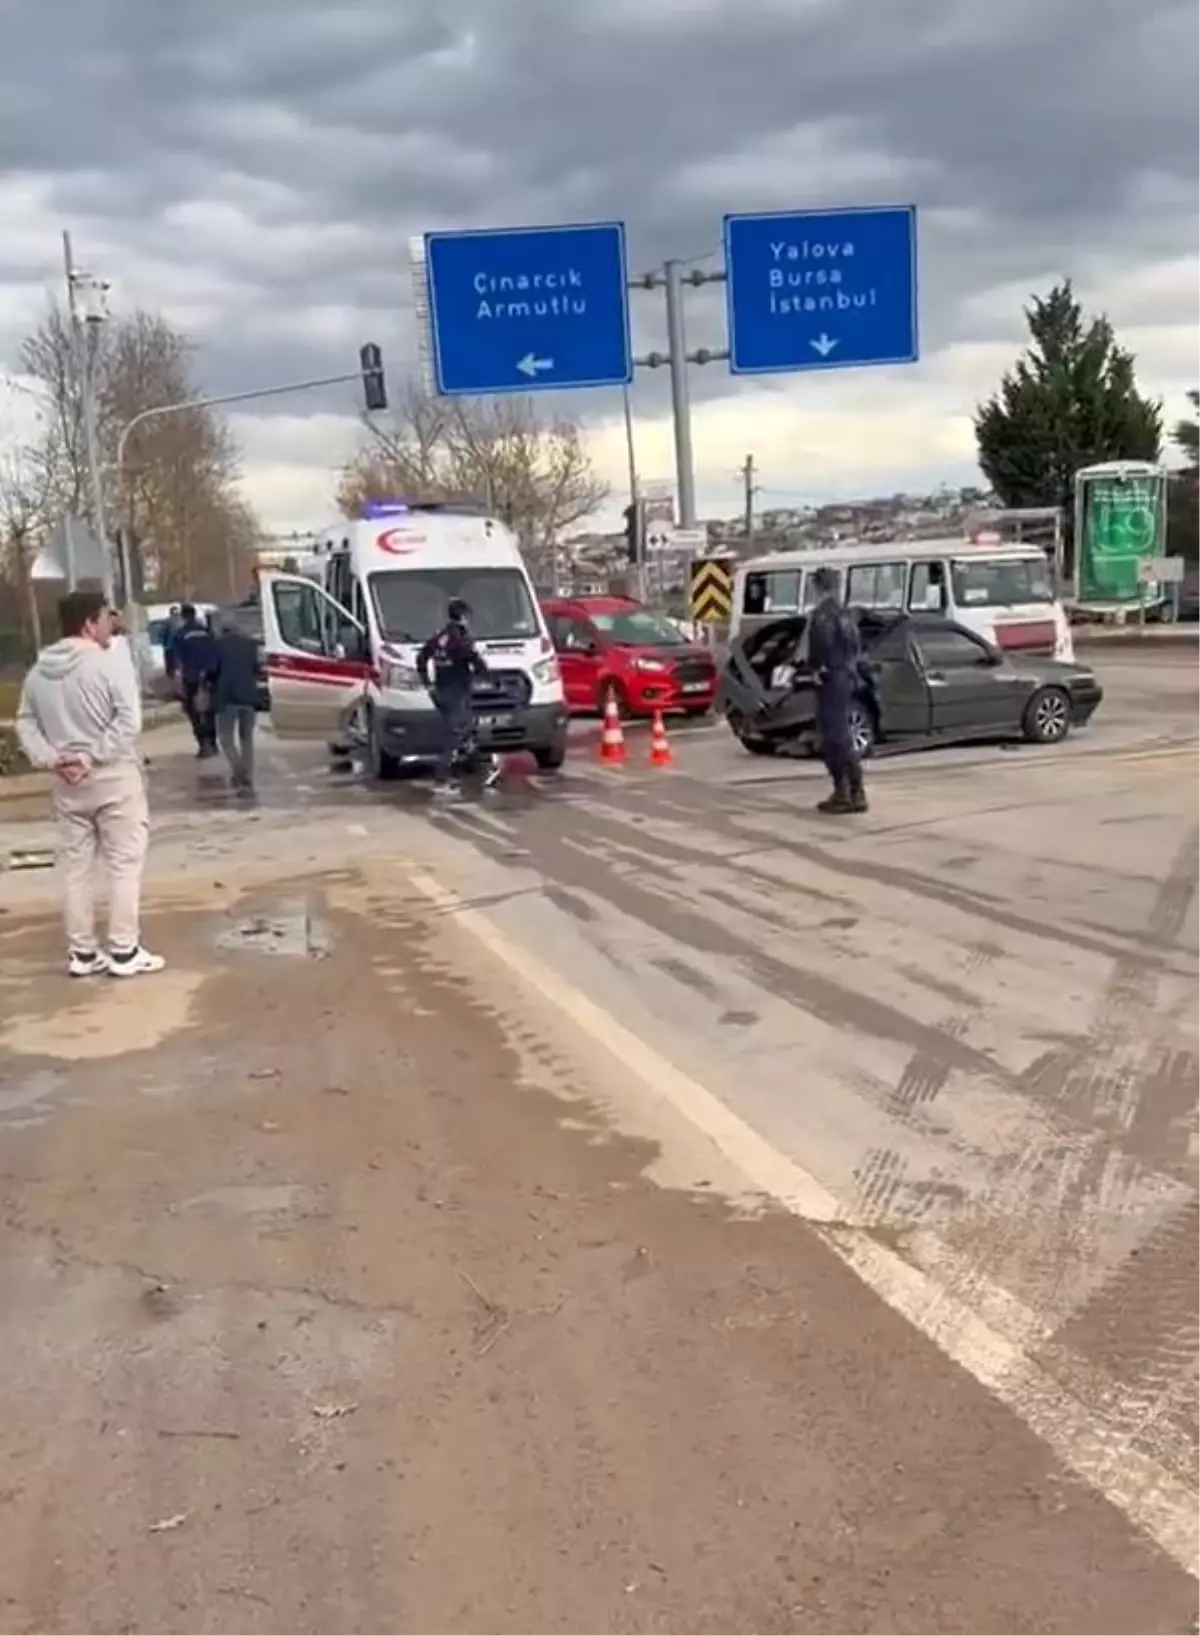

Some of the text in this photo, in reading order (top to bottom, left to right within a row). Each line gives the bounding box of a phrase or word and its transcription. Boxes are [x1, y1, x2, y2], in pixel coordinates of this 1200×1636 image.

[770, 240, 854, 260] Yalova
[473, 268, 582, 294] Çınarcık
[770, 268, 842, 288] Bursa
[476, 296, 586, 319] Armutlu
[770, 289, 876, 314] İstanbul
